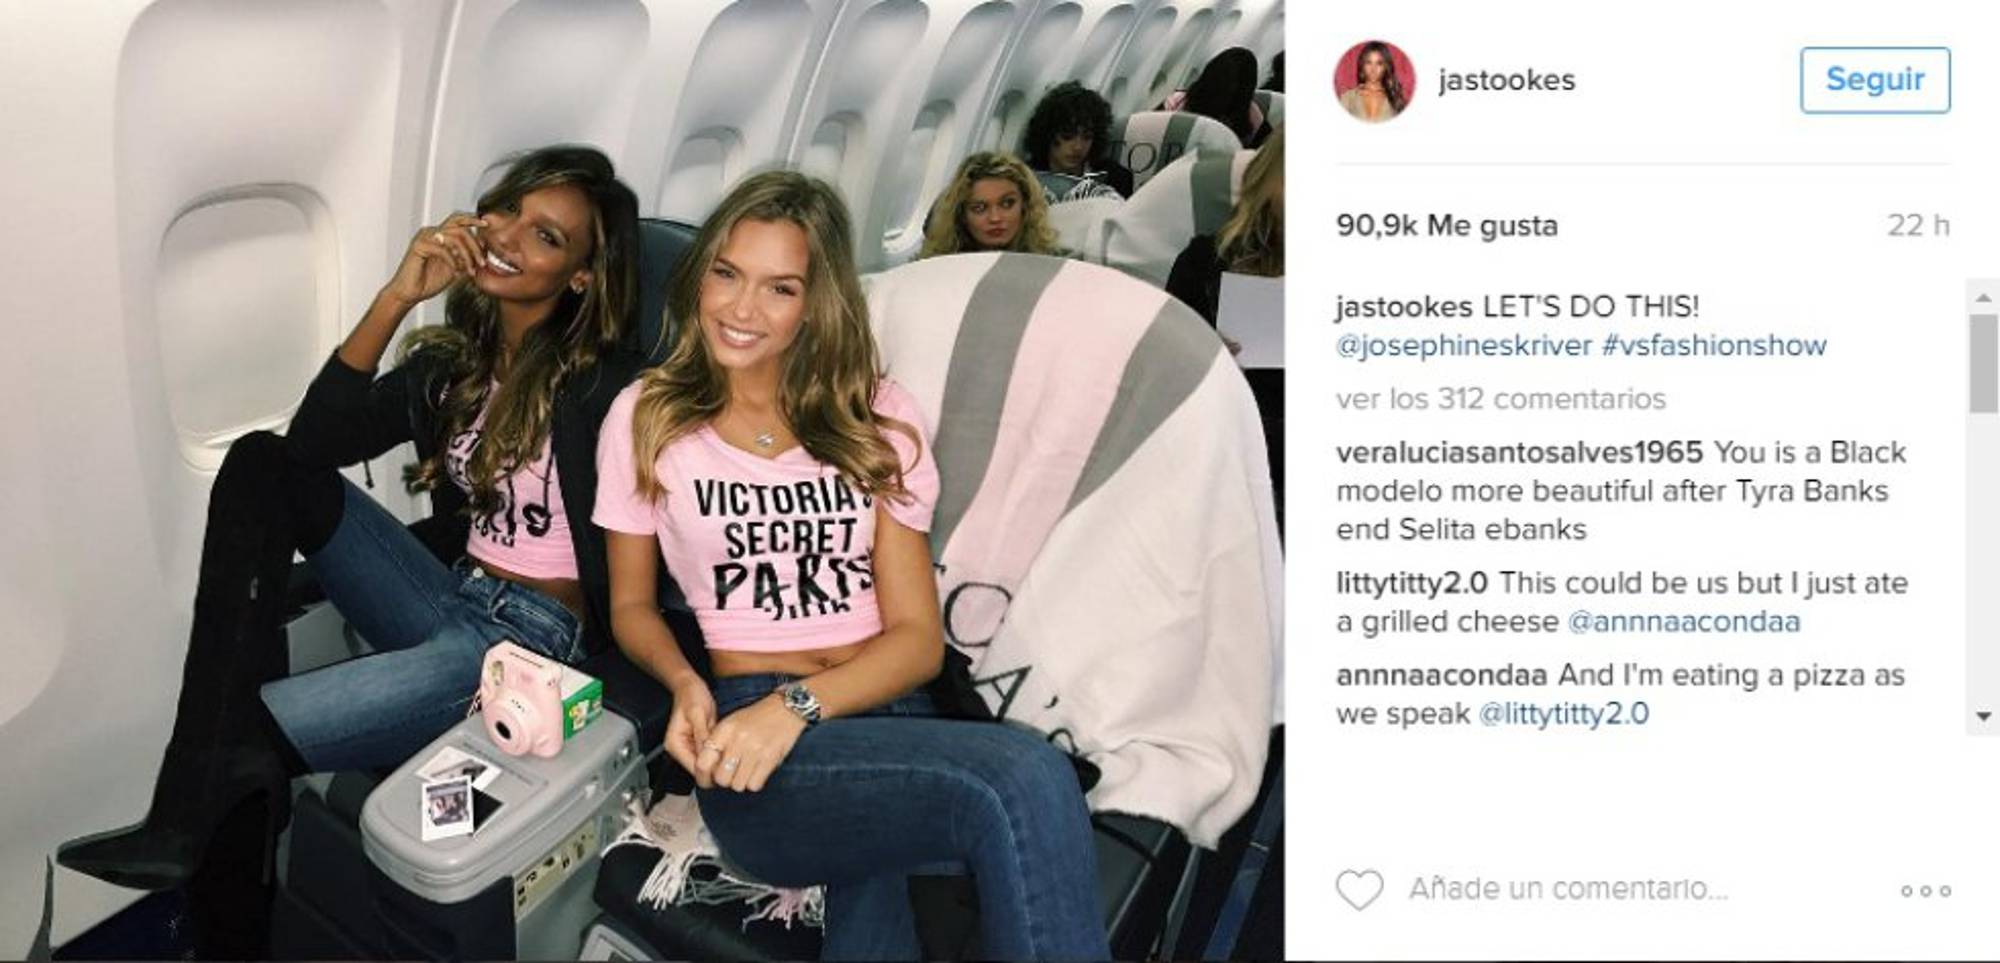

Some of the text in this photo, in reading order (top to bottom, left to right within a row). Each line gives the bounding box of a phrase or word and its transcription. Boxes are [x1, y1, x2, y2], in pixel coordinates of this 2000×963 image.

[1438, 67, 1576, 97] jastookes
[1827, 65, 1925, 97] Seguir
[1336, 213, 1558, 243] 90,9k Me gusta
[1888, 213, 1950, 236] 22 h
[1333, 294, 1699, 324] jastookes LET'S DO THIS!
[1337, 333, 1827, 363] @josephineskriver #vsfashionshow
[1336, 387, 1666, 410] ver los 312 comentarios
[1336, 440, 1906, 464] veraluciasantosalves1965 You is a Black
[1337, 479, 1889, 508] modelo more beautiful after Tyra Banks
[724, 518, 857, 559] SECRET
[1336, 517, 1588, 541] end Selita ebanks
[713, 552, 873, 611] PARIS
[1337, 571, 1909, 600] littytitty2.0 This could be us but I just ate
[1336, 609, 1800, 639] a grilled cheese @annnaacondaa
[1336, 662, 1905, 692] annnaacondaa And I'm eating a pizza as
[1336, 701, 1649, 731] we speak @littytitty2.0
[1409, 875, 1500, 900] Añade
[1509, 881, 1543, 900] un
